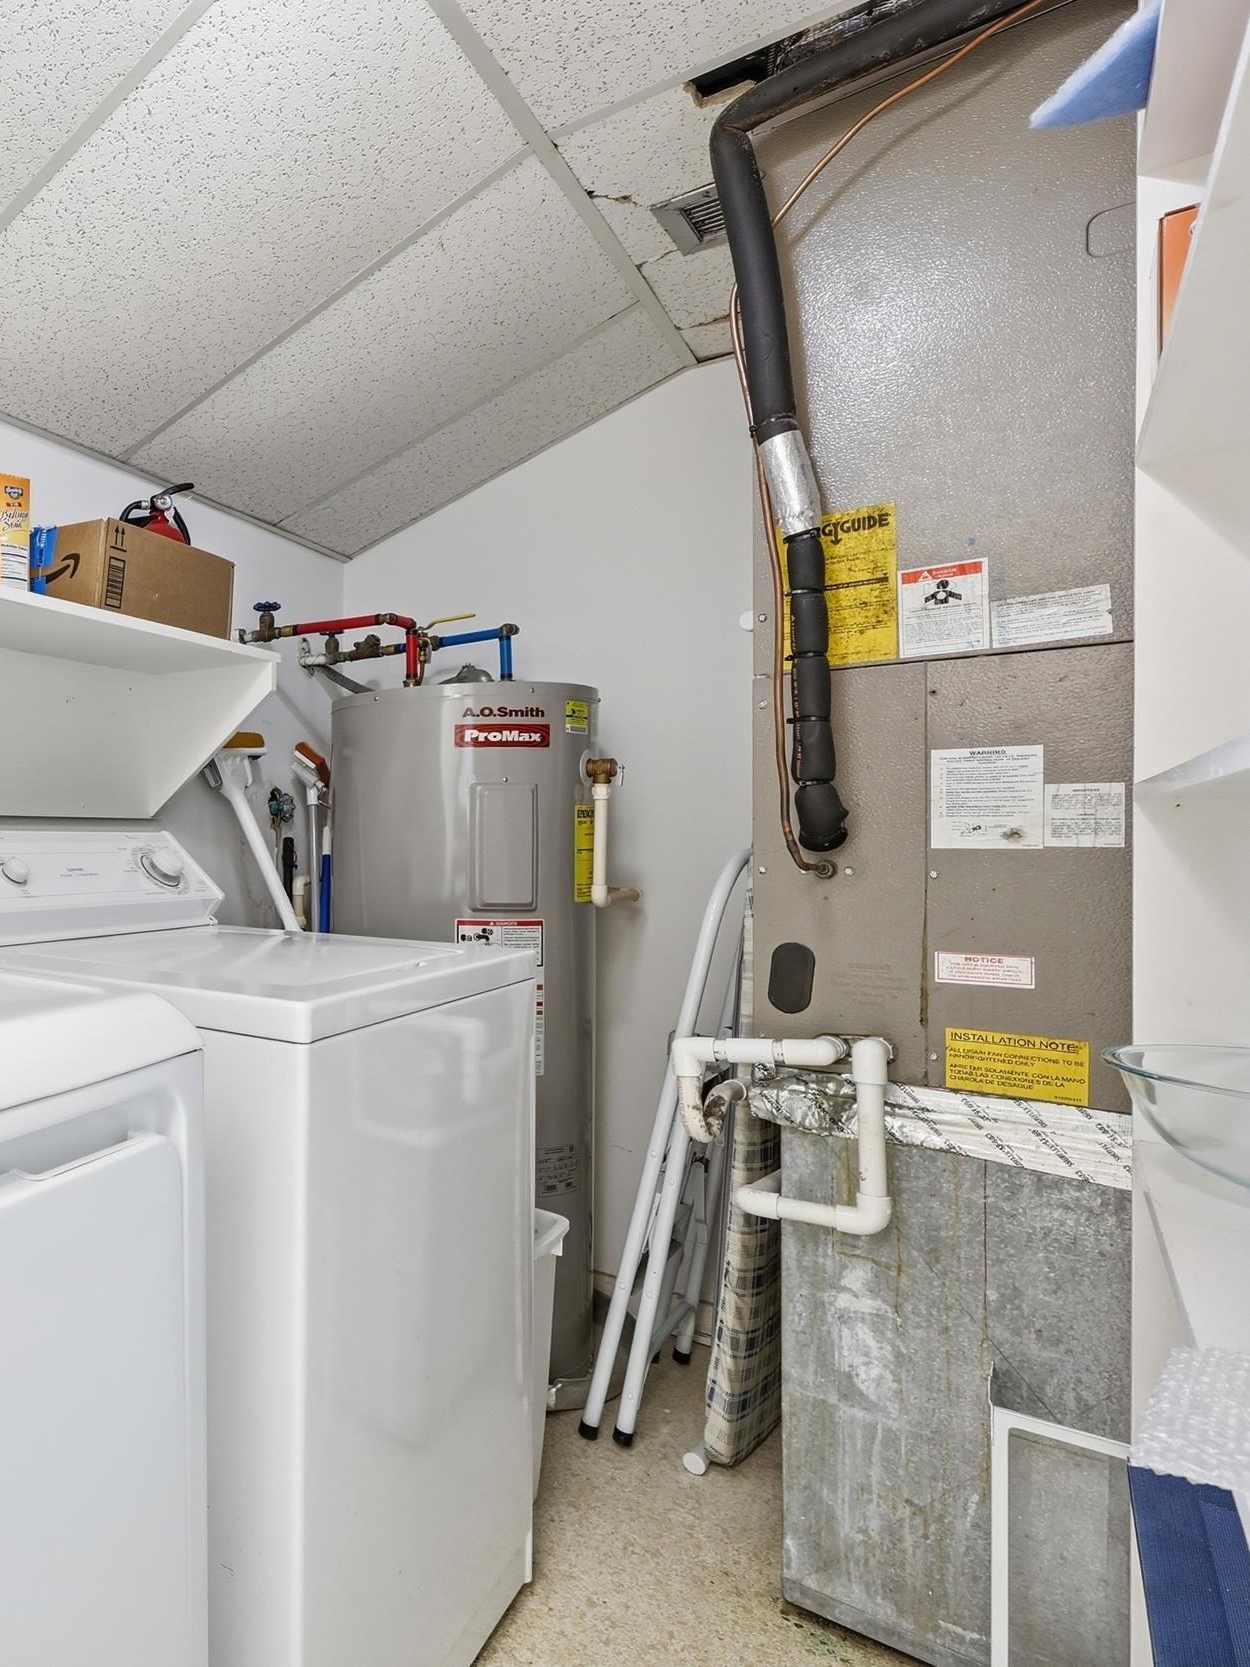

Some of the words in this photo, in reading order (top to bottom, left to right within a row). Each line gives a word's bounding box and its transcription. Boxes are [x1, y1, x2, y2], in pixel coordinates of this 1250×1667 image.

[461, 706, 545, 718] A.O.Smith
[464, 729, 543, 742] ProMax
[964, 956, 1004, 964] NOTICE
[950, 1031, 1036, 1048] INSTALLATION
[1004, 1053, 1060, 1065] CONNECTIONS
[1061, 1059, 1072, 1067] TO
[1074, 1060, 1085, 1068] BE
[1015, 1059, 1036, 1067] ONLY
[1031, 1072, 1050, 1080] CON
[1061, 1076, 1086, 1085] MANO
